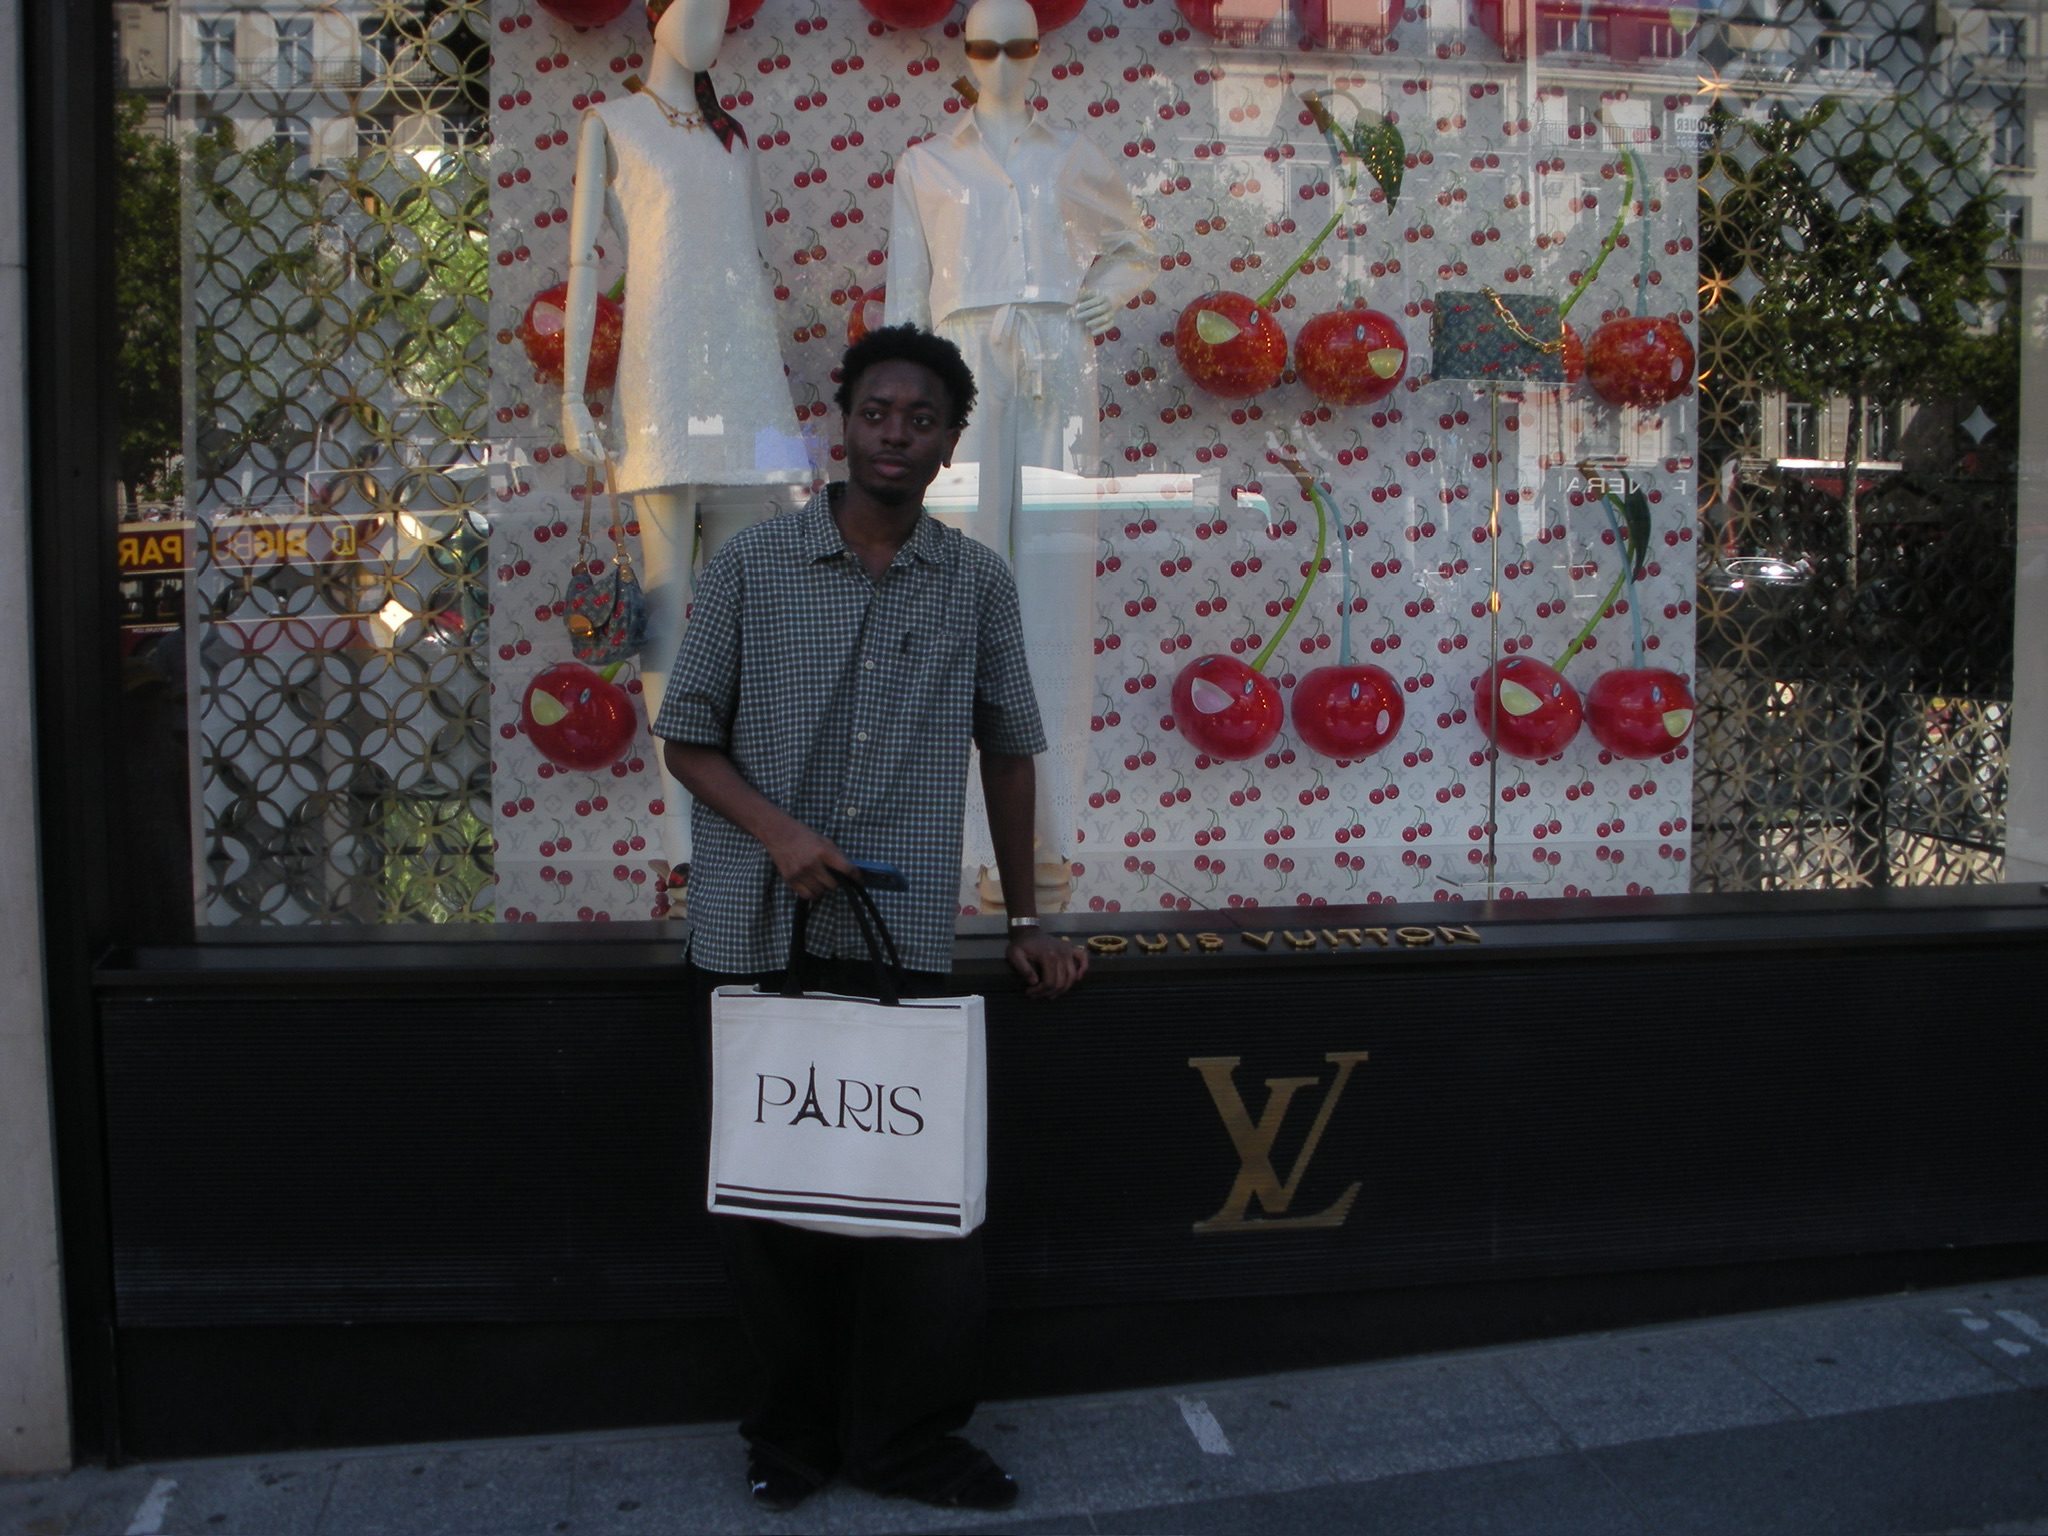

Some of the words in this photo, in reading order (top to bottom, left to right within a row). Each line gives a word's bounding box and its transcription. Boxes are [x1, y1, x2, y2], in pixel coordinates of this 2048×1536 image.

[1064, 931, 1224, 952] OUIS
[1241, 925, 1481, 951] VUITTON
[754, 1061, 924, 1136] PARIS
[1188, 1052, 1368, 1232] LV
